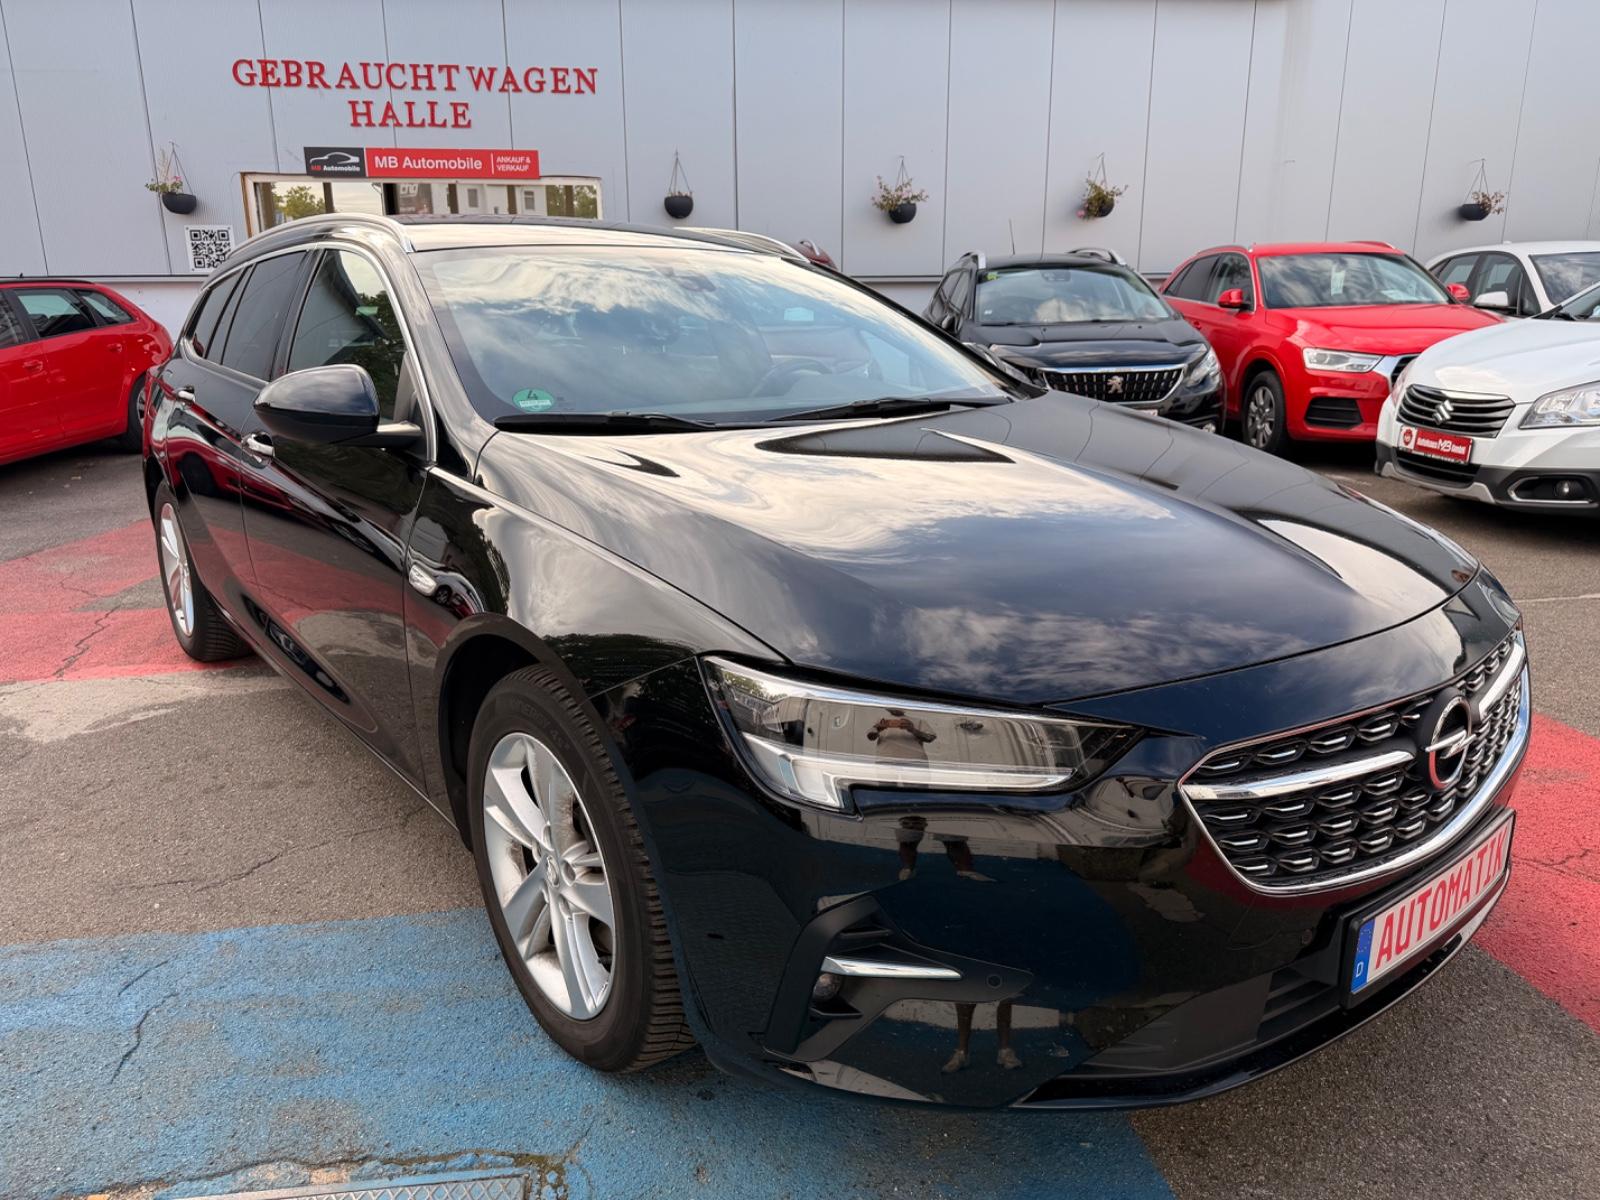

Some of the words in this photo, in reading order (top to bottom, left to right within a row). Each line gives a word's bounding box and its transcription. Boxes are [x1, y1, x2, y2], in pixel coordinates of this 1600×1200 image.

[347, 100, 472, 128] HALLE
[374, 155, 399, 169] MB
[402, 156, 483, 170] Automobile
[496, 164, 530, 172] VERKAUF
[527, 389, 539, 401] 4
[1375, 826, 1508, 970] AUTOMATIK
[1355, 961, 1364, 978] D
